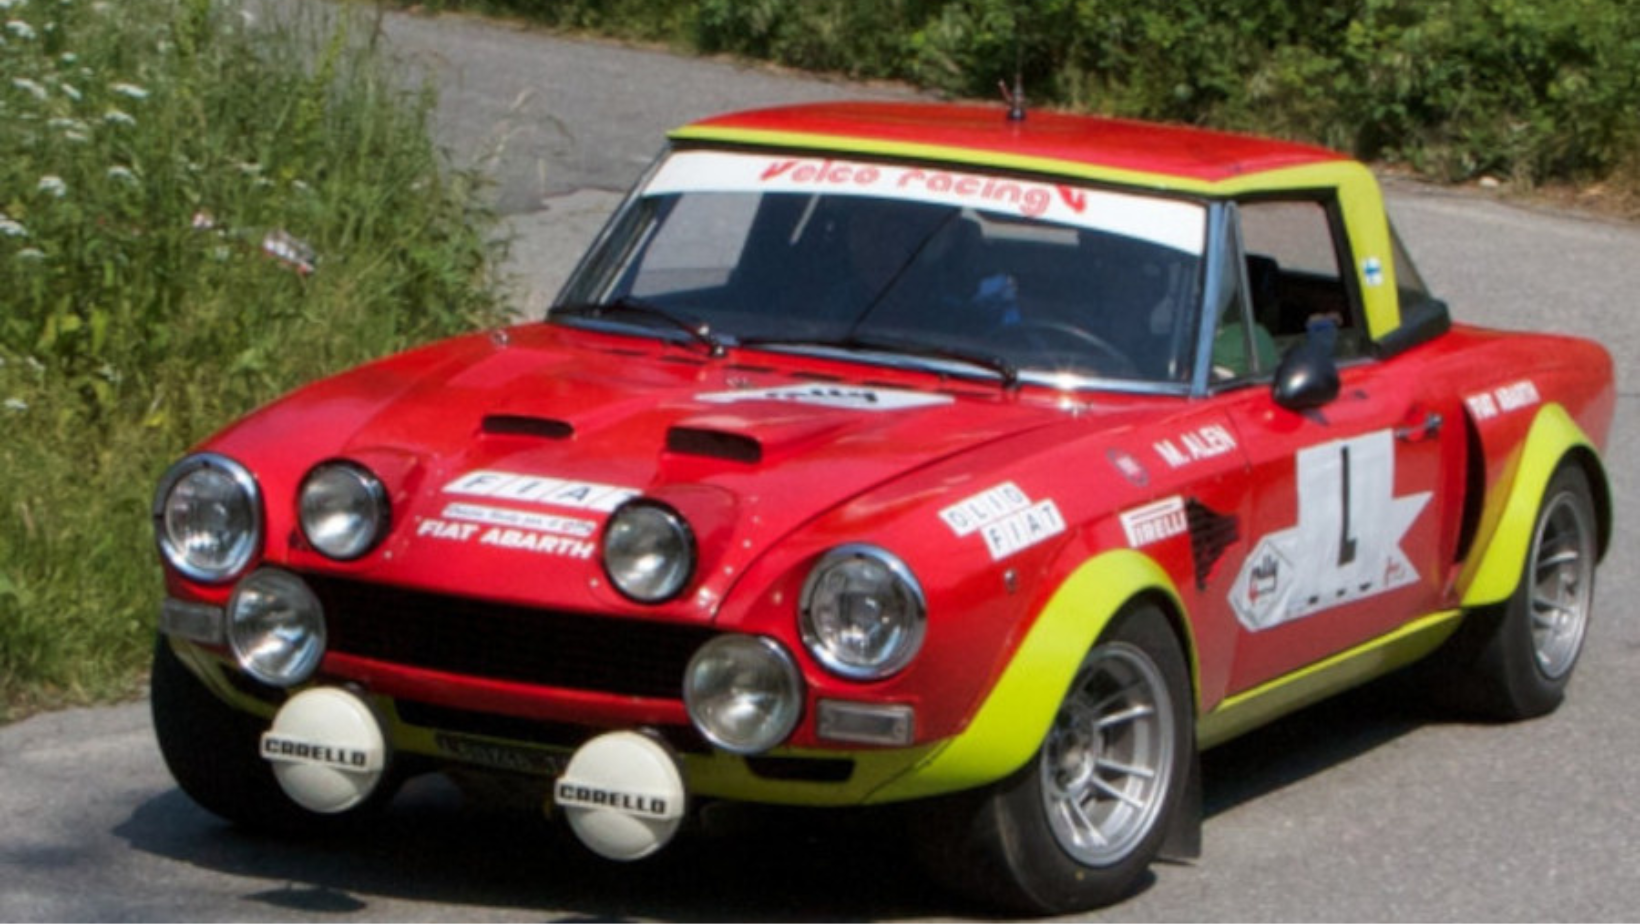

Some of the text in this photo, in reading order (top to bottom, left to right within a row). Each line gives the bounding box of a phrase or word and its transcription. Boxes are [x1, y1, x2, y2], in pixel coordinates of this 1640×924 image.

[897, 166, 1052, 217] racing
[1180, 424, 1238, 461] ALEN
[462, 474, 640, 502] FIA
[417, 518, 480, 540] FIAT
[479, 527, 595, 560] ABARTH
[989, 504, 1060, 552] FIAT
[265, 738, 367, 768] CARELLO
[560, 784, 666, 816] CARELLO
